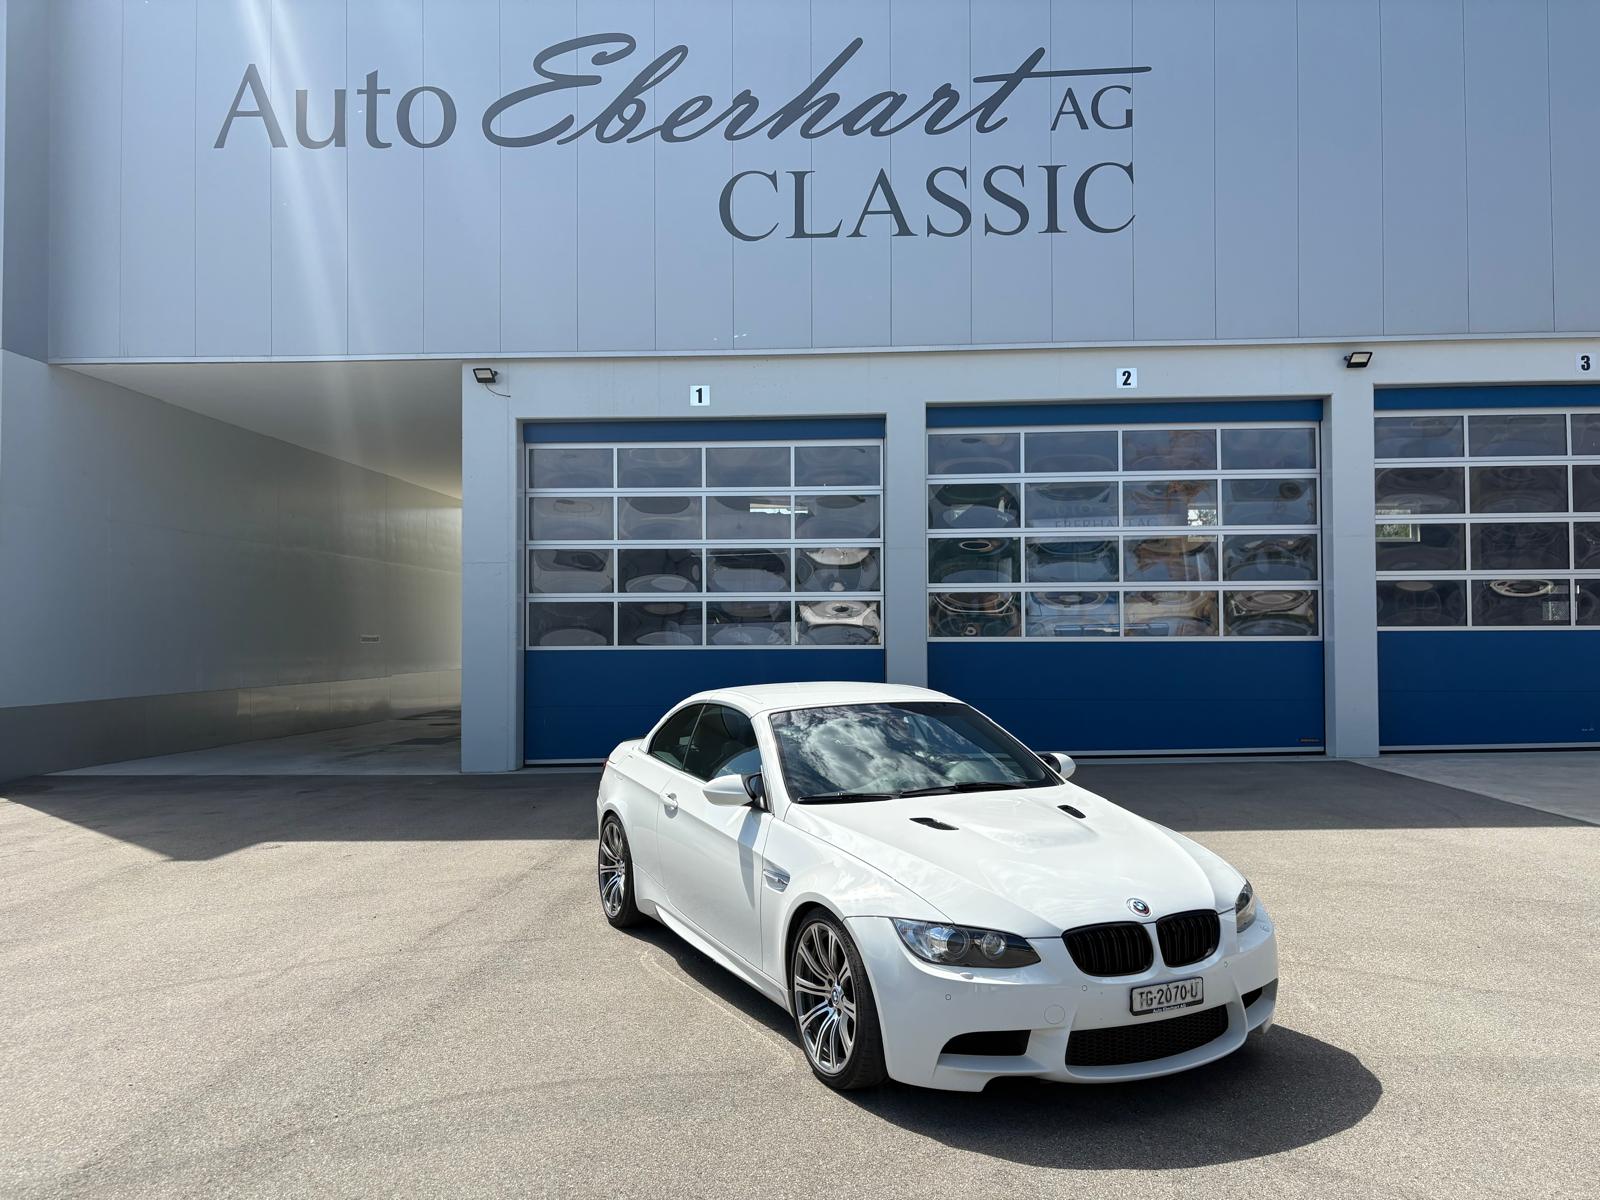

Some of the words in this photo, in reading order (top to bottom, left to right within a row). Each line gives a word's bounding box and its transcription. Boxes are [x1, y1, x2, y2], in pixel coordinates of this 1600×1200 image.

[213, 63, 457, 149] Auto
[482, 32, 1152, 148] Eberhart
[1050, 85, 1133, 131] AG
[719, 161, 1136, 242] CLASSIC
[1580, 355, 1591, 371] 3
[1122, 370, 1132, 386] 2
[695, 387, 703, 404] 1
